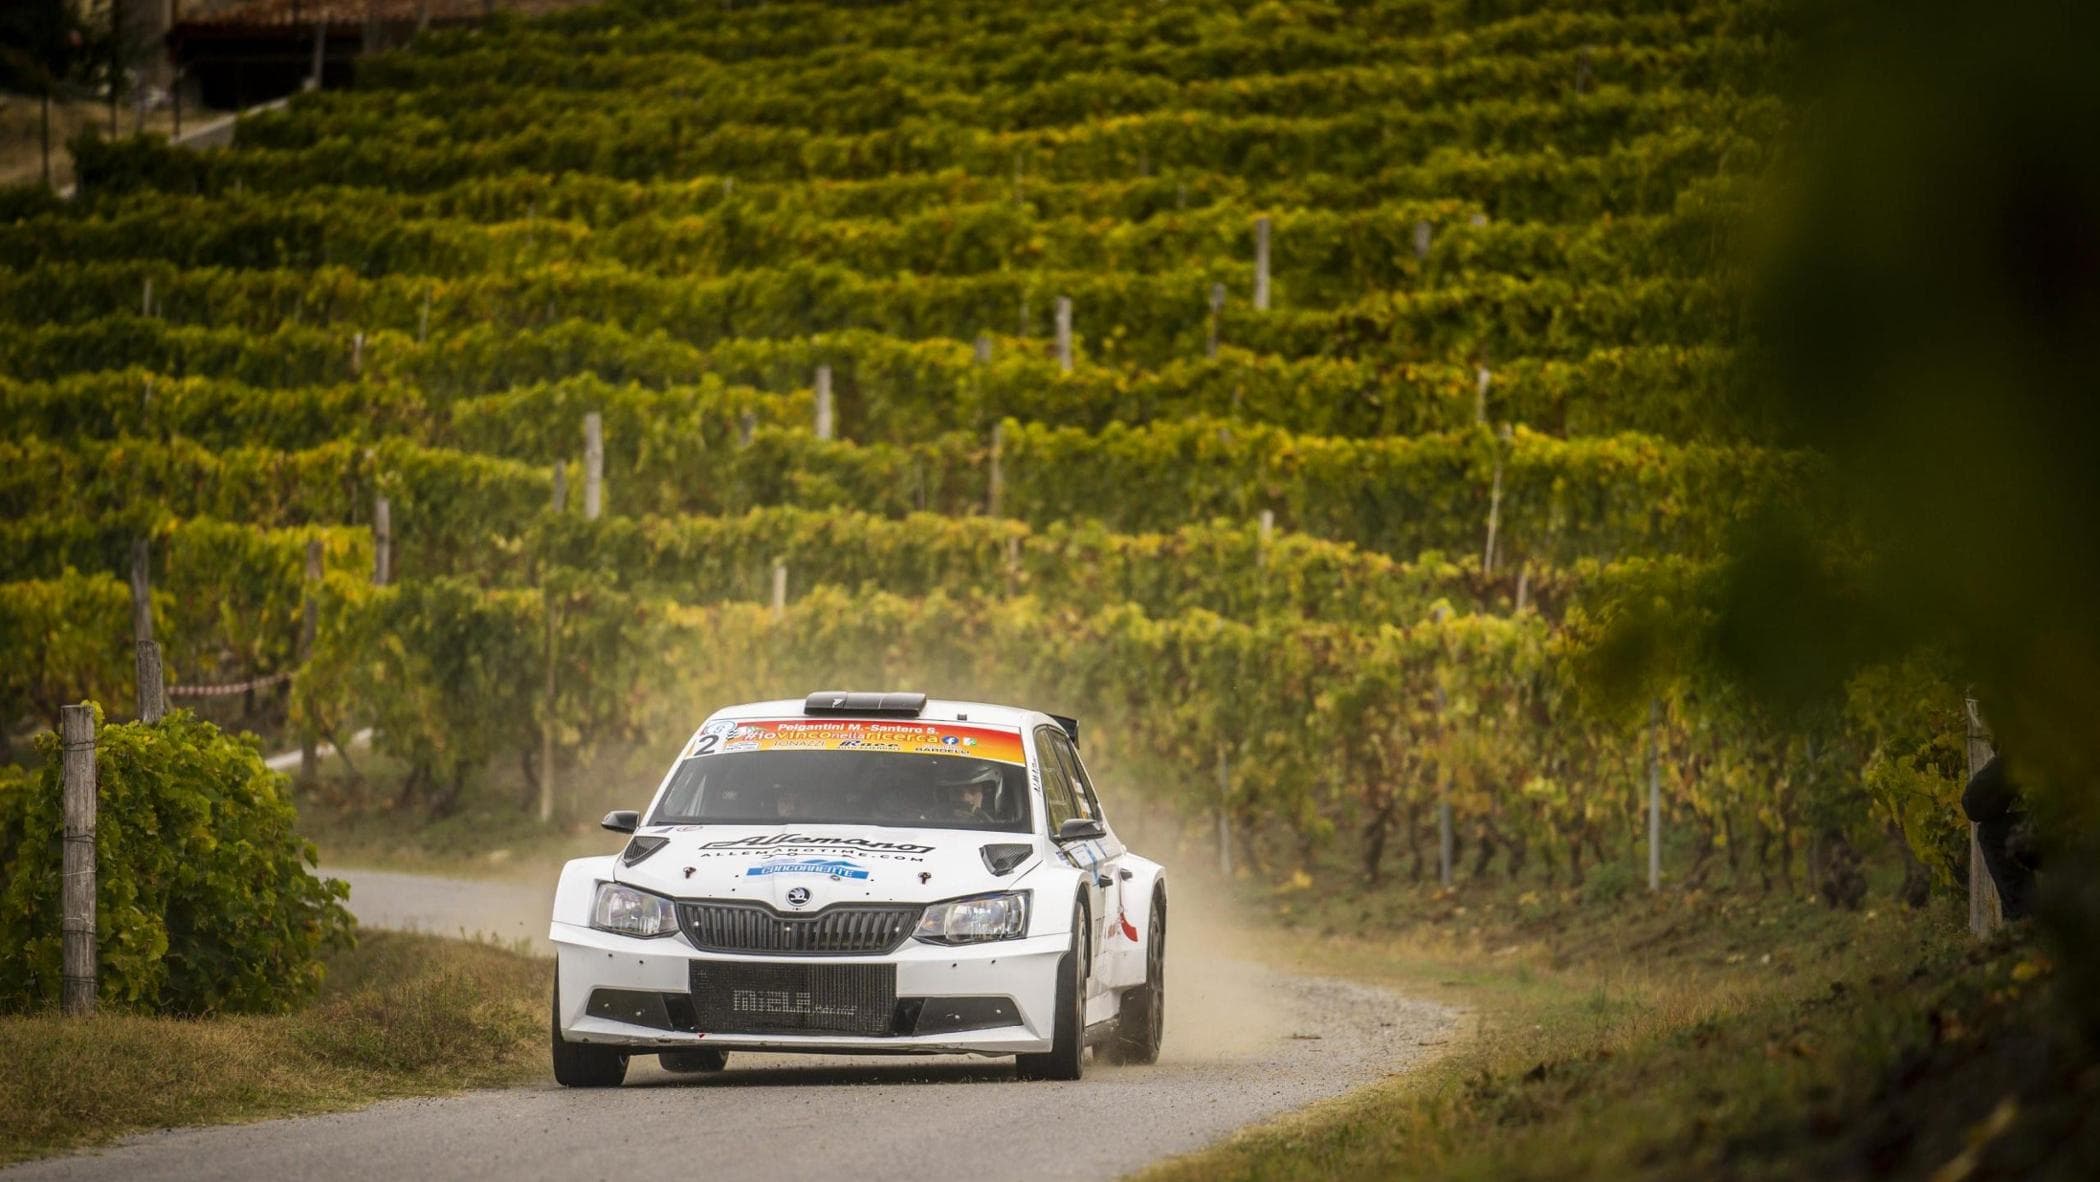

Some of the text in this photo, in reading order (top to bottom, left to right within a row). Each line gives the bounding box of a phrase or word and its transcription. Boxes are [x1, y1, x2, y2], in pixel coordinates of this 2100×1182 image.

[926, 726, 939, 735] S.
[694, 734, 720, 757] 2
[699, 833, 936, 854] Allemano
[701, 848, 924, 863] ALLEMANOTIME.COM
